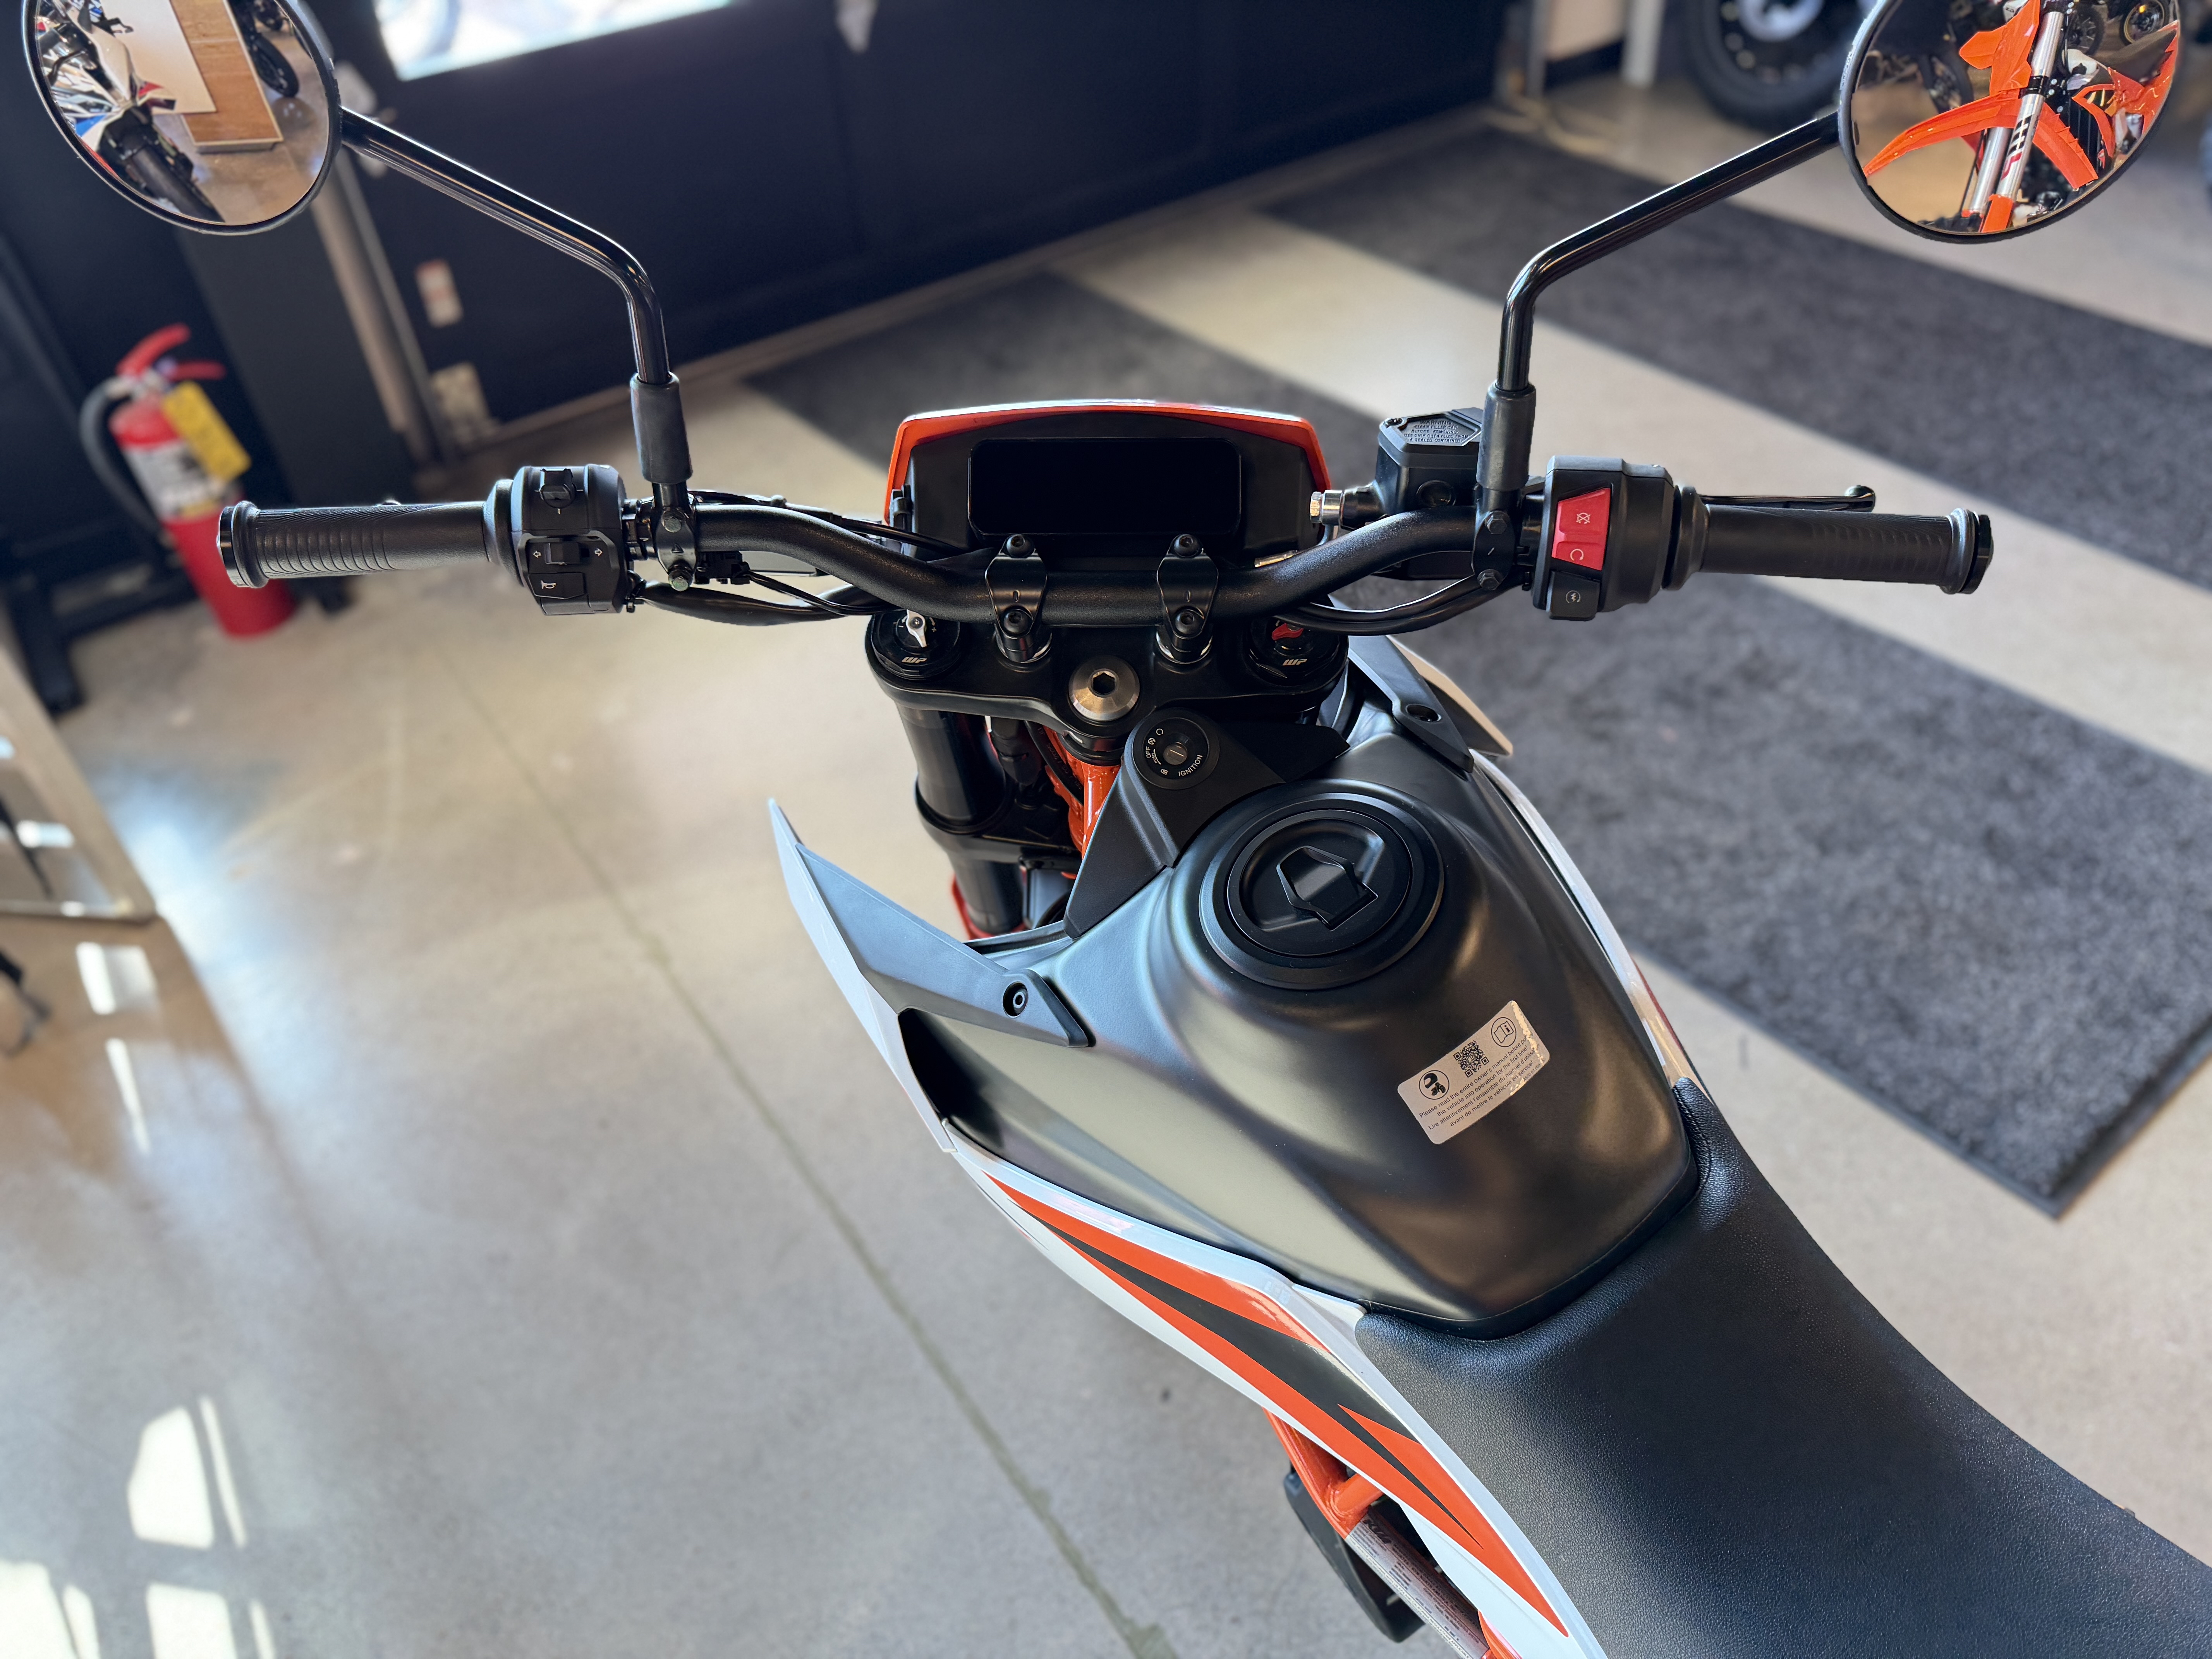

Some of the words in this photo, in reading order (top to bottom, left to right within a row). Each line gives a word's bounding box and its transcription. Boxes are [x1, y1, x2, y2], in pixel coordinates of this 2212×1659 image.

[1178, 755, 1203, 777] IGNITION
[1419, 1106, 1438, 1118] Please
[1438, 1097, 1450, 1107] read
[1450, 1092, 1459, 1100] the
[1459, 1082, 1474, 1093] entire
[1474, 1068, 1492, 1083] owner's
[1492, 1053, 1509, 1070] manual
[1507, 1042, 1521, 1056] before
[1446, 1097, 1465, 1111] vehicle
[1464, 1091, 1474, 1099] into
[1474, 1074, 1497, 1092] operation
[1510, 1054, 1519, 1064] first
[1439, 1100, 1474, 1124] attentivement
[1472, 1082, 1499, 1102] l'ensemble
[1450, 1115, 1465, 1127] avant
[1472, 1099, 1488, 1112] mettre
